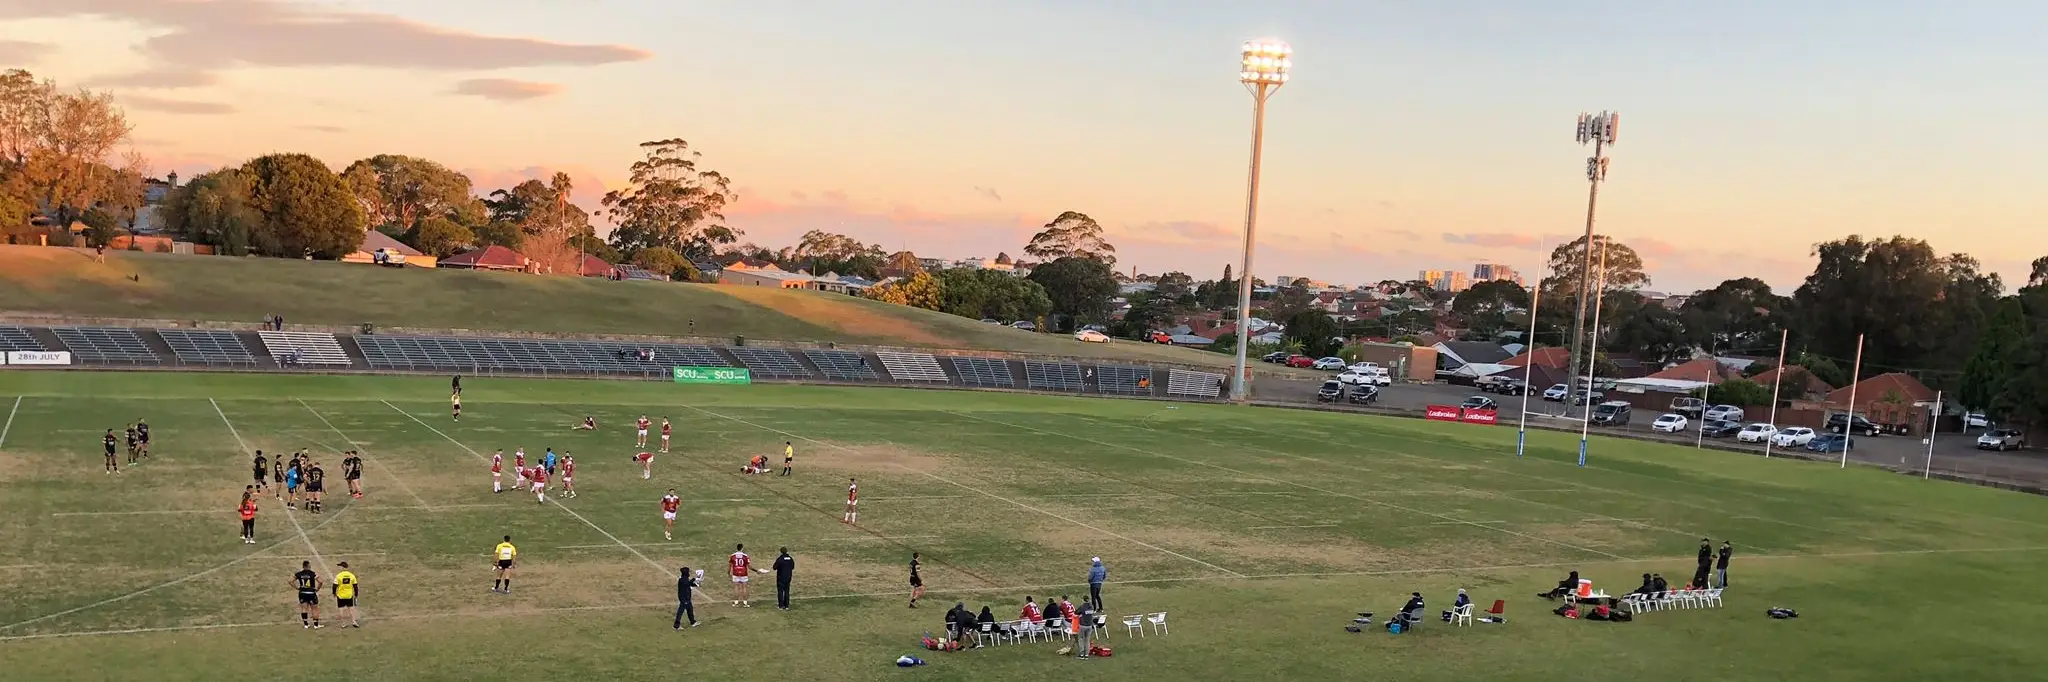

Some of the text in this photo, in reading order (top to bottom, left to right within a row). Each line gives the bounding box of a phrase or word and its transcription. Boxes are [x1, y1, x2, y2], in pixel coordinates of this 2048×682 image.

[676, 369, 697, 379] SCU
[714, 370, 734, 379] SCU
[1428, 410, 1457, 418] Ladbrokes
[1465, 412, 1494, 421] Ladbrokes
[734, 558, 744, 566] 10
[301, 579, 311, 588] 14
